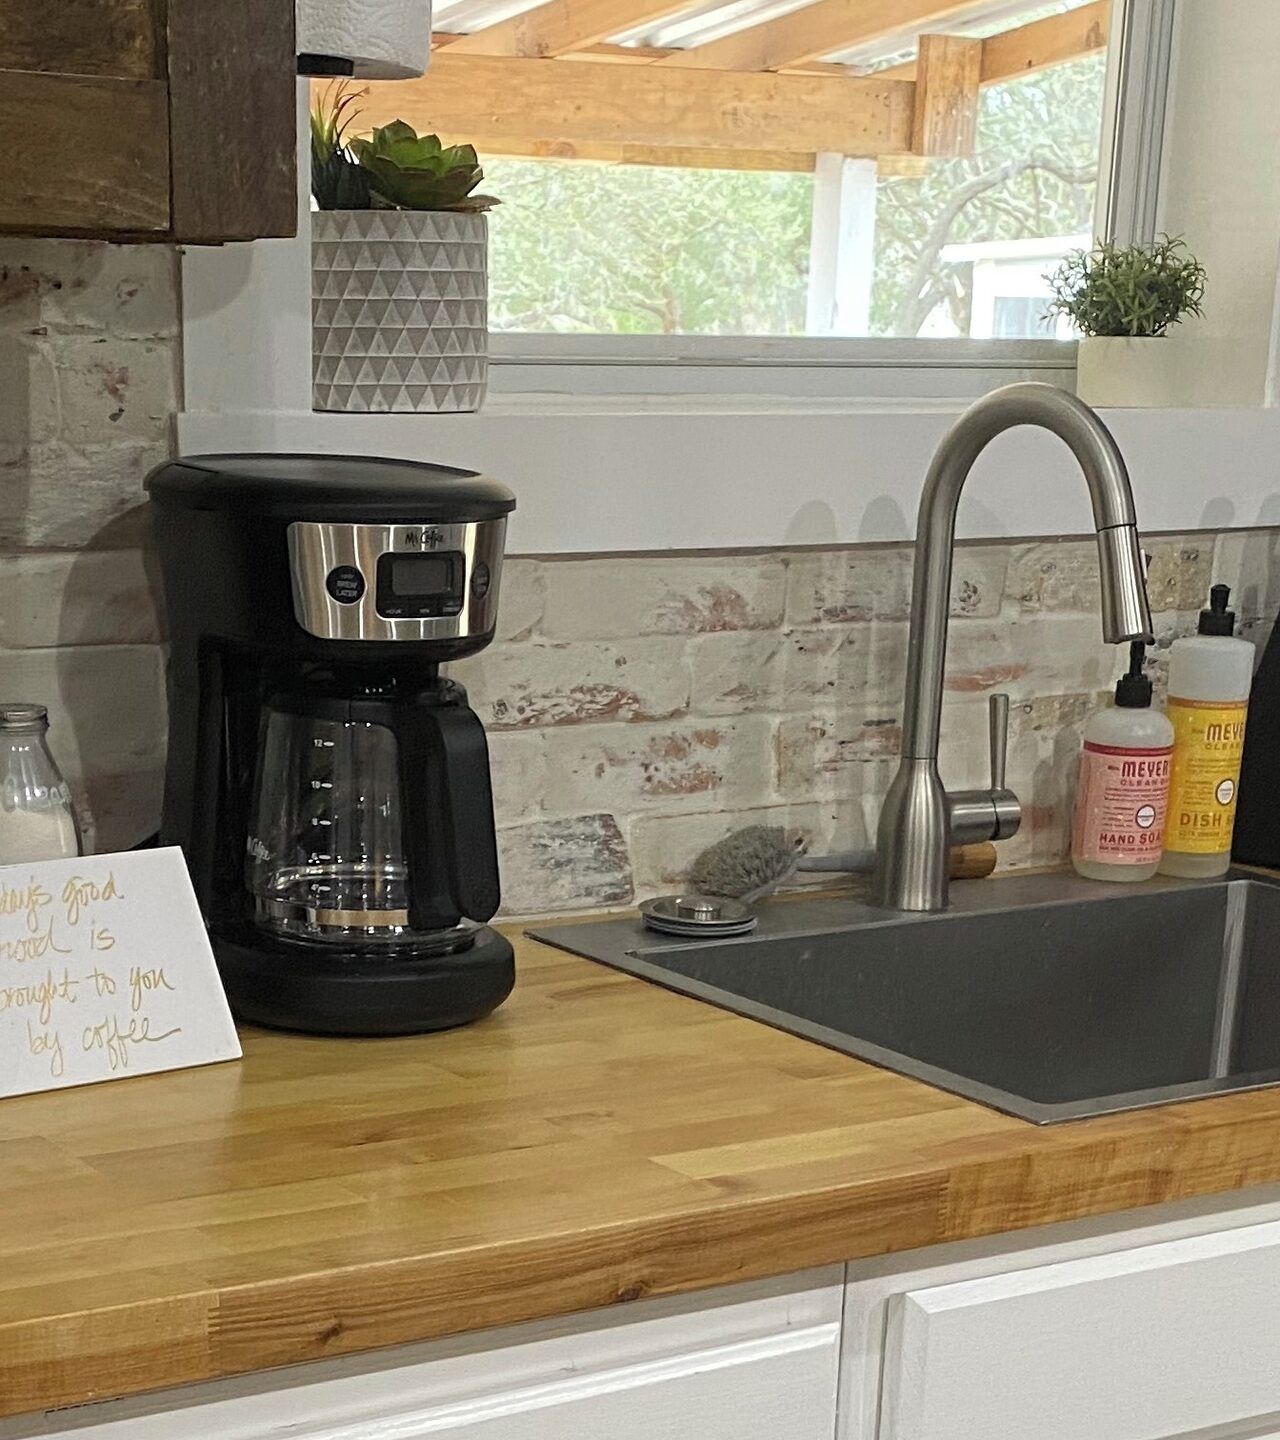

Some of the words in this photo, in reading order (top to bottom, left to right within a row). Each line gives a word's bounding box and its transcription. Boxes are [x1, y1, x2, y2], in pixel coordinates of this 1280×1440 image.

[313, 738, 323, 748] 12
[1179, 813, 1222, 827] DISH
[1099, 832, 1136, 845] HAND
[89, 919, 117, 951] is
[86, 966, 116, 996] to
[129, 966, 176, 1012] you
[27, 1019, 64, 1078] by
[81, 1014, 182, 1071] coffee
